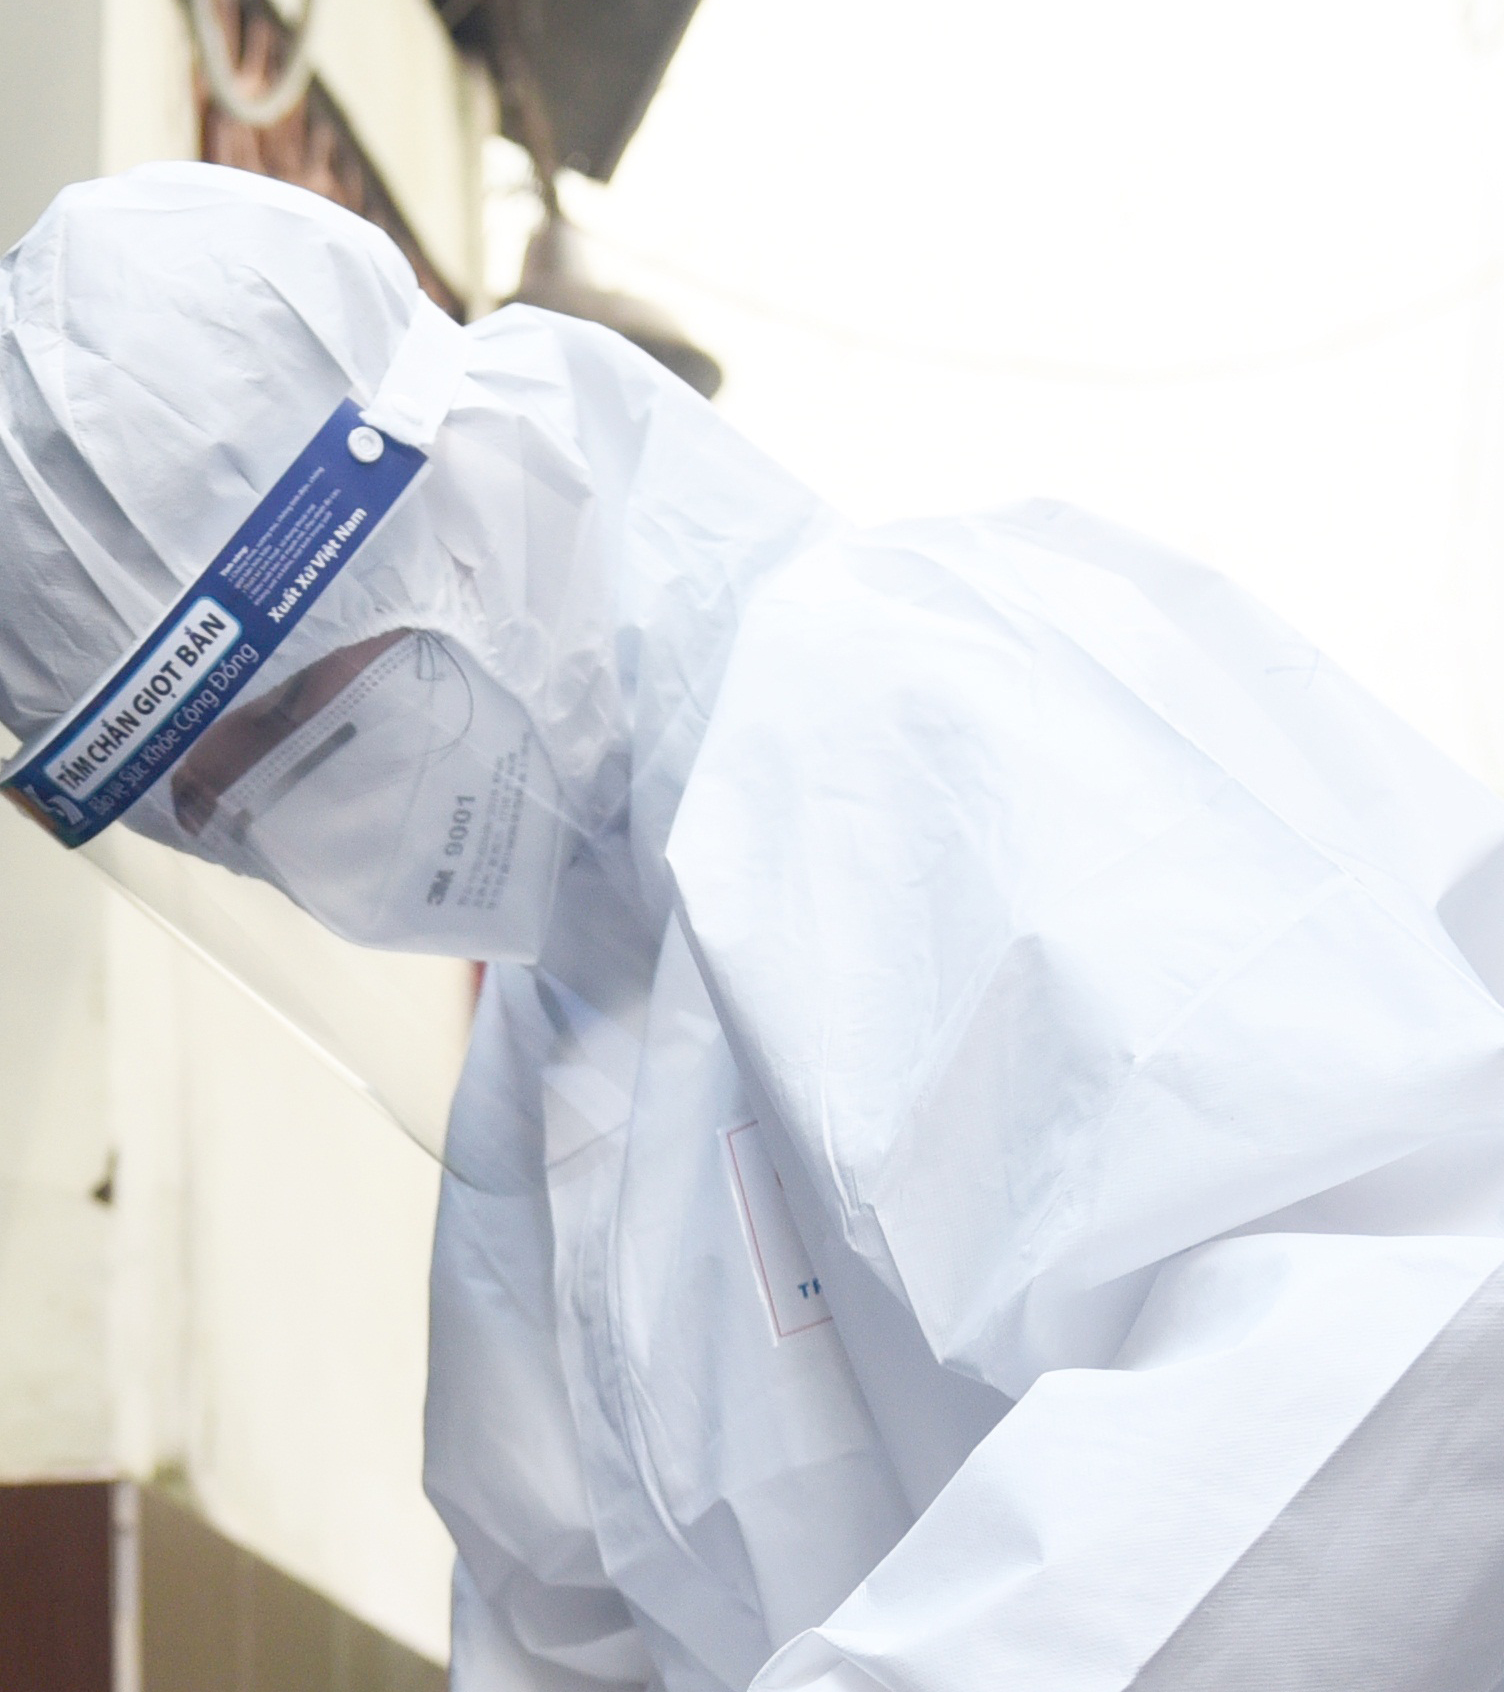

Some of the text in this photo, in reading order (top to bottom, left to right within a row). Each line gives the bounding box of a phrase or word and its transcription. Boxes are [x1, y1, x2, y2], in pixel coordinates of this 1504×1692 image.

[267, 587, 302, 623] Xuất
[310, 539, 341, 568] Việt
[333, 507, 368, 542] Nam
[56, 755, 96, 791] TẤM
[132, 661, 183, 716] GIỌT
[173, 688, 220, 730] Cộng
[445, 796, 476, 856] 9001
